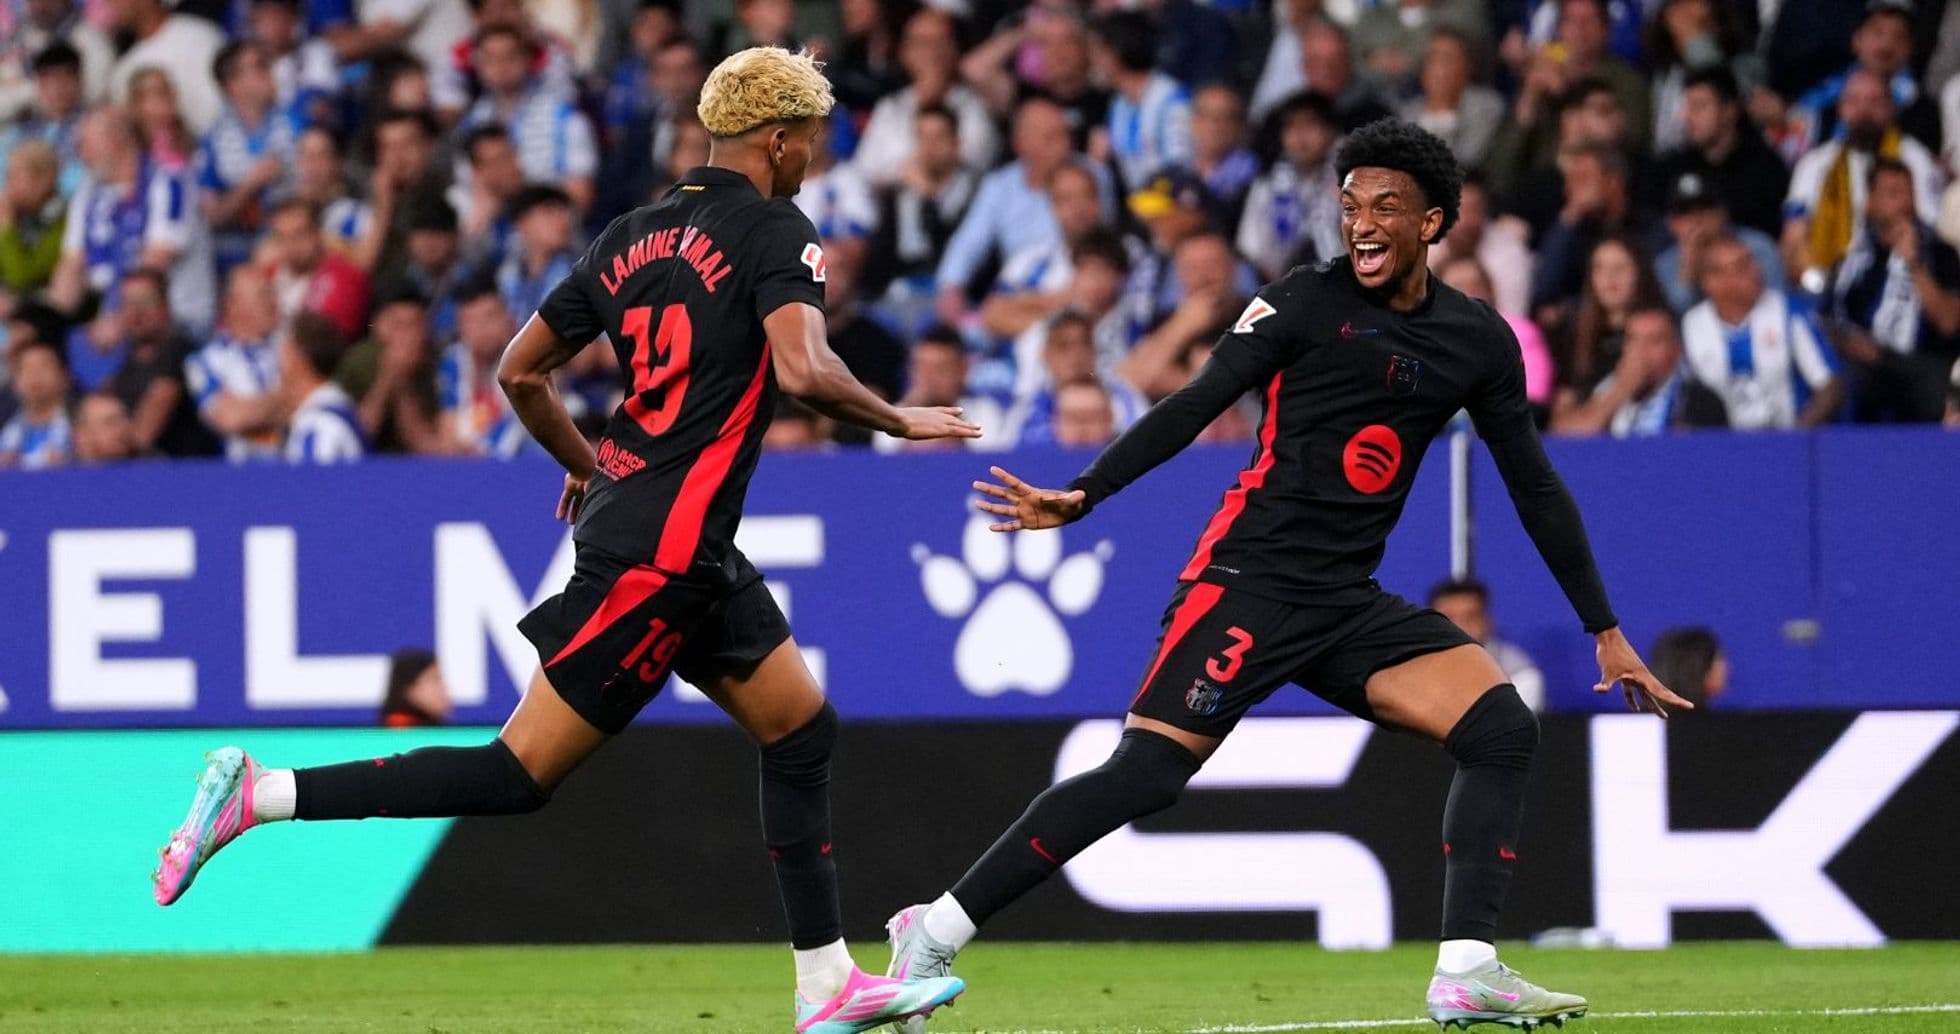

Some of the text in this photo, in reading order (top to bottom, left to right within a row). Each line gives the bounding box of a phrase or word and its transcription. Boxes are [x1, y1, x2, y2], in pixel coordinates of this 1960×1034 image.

[600, 227, 680, 296] LAMINE
[621, 303, 692, 436] 19
[0, 514, 825, 711] ELM
[619, 617, 683, 683] 19
[1205, 626, 1254, 682] 3
